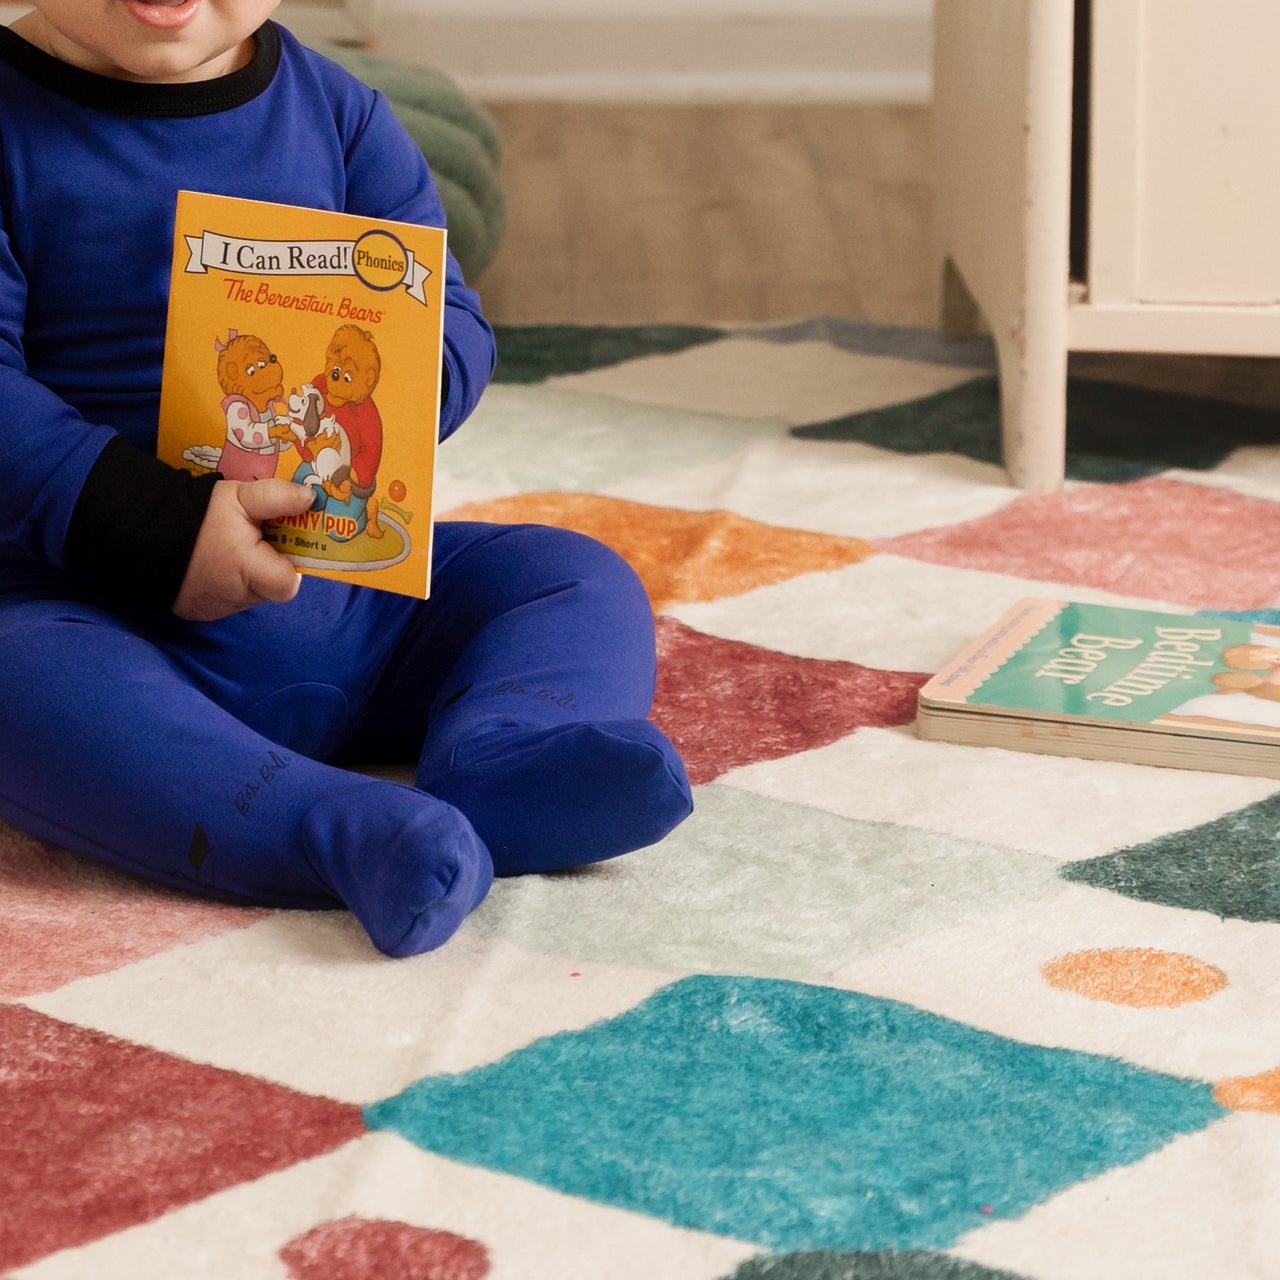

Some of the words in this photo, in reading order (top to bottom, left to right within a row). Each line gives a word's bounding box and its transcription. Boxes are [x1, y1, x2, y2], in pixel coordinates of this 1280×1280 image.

[219, 241, 231, 266] I
[236, 245, 281, 271] Can
[287, 245, 348, 270] Read!
[356, 249, 405, 273] Phonics
[223, 278, 253, 304] The
[253, 282, 334, 316] Berenstain
[336, 296, 383, 324] Bears
[276, 511, 321, 531] UNNY
[325, 515, 357, 537] PUP
[294, 536, 319, 550] Short
[1034, 632, 1144, 685] Bear
[1085, 625, 1223, 707] Bedtime
